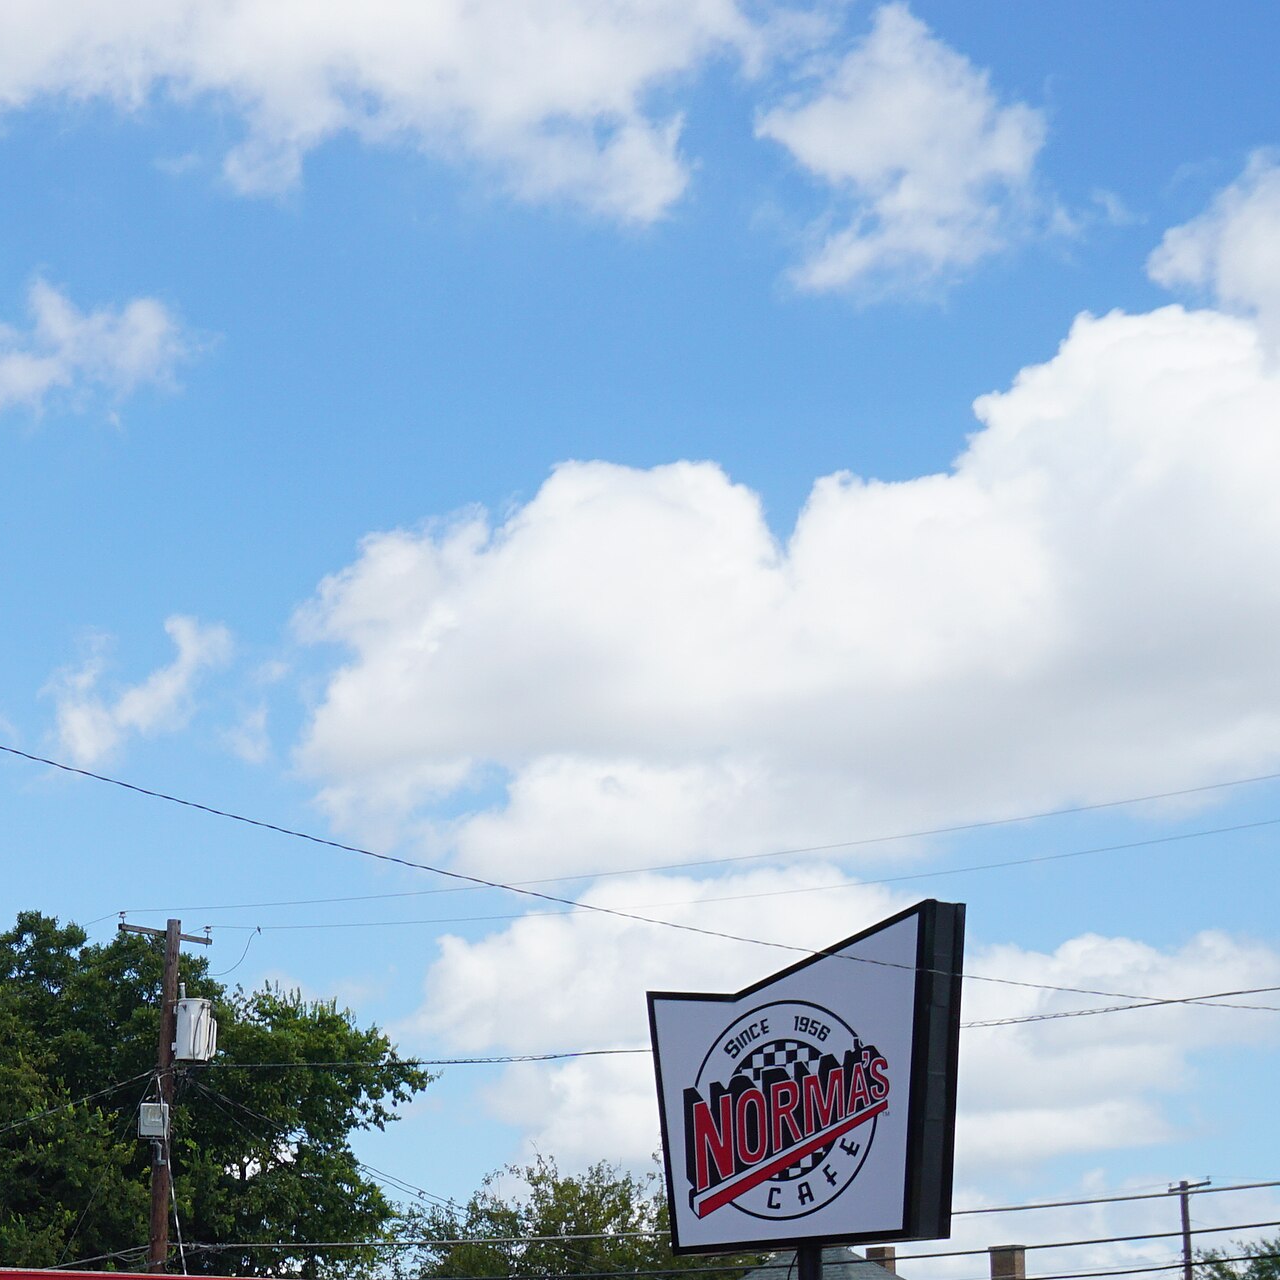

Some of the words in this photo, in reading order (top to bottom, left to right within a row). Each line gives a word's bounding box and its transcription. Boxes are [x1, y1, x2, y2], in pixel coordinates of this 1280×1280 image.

[723, 1018, 770, 1059] SINCE
[793, 1016, 831, 1042] 1956
[692, 1050, 890, 1191] NORMA'S
[767, 1137, 860, 1210] CAFE
